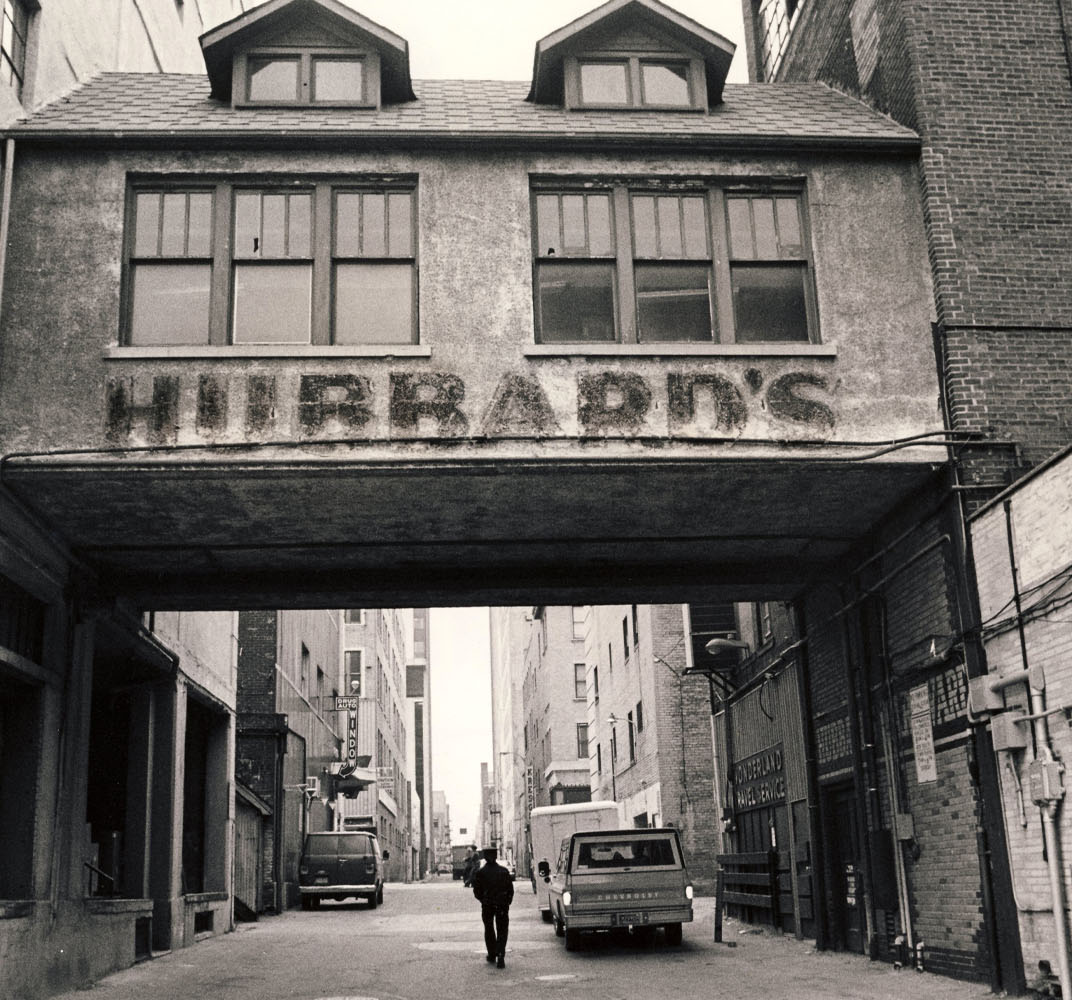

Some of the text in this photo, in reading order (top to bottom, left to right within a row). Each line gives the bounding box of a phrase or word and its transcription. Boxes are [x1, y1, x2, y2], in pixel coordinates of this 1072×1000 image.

[105, 368, 836, 440] HUBBARD'S
[735, 750, 783, 785] ONDERLAND
[737, 787, 756, 808] RAVEL
[597, 892, 659, 901] CHEVROLET
